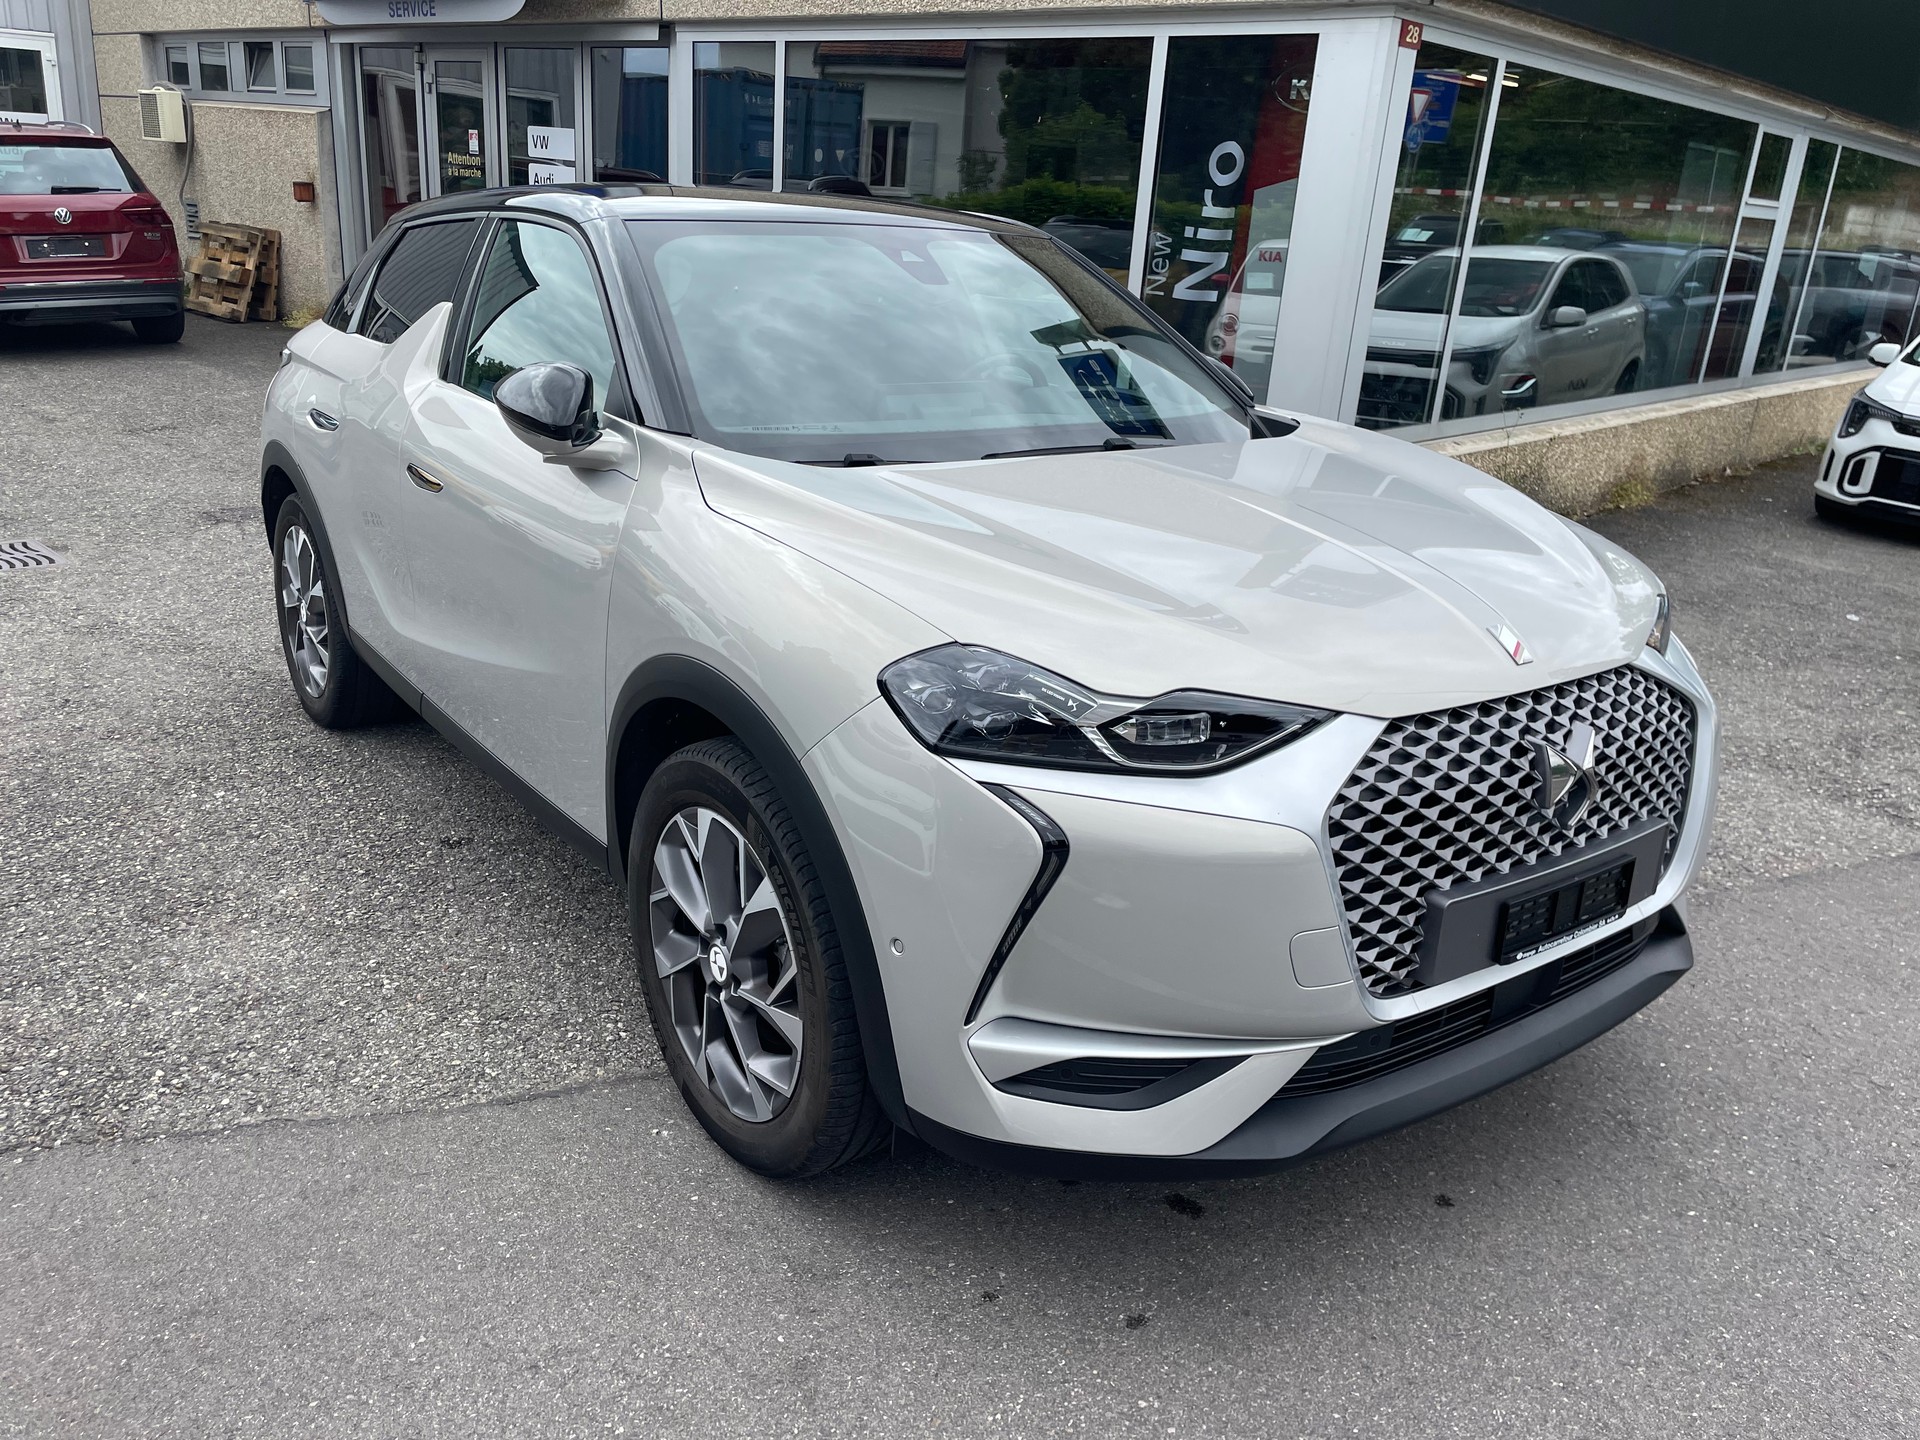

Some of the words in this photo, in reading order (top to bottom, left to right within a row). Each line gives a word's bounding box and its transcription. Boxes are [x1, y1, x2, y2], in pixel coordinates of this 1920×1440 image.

[388, 0, 436, 18] SERVICE
[1406, 24, 1420, 44] 28
[531, 134, 549, 150] VW
[447, 151, 481, 166] Attention
[453, 166, 459, 176] la
[459, 167, 482, 178] marche
[533, 172, 554, 185] Audi
[1172, 140, 1245, 303] Niro
[1145, 232, 1173, 296] New
[1258, 250, 1282, 263] KIA
[770, 865, 815, 992] MICHELIN
